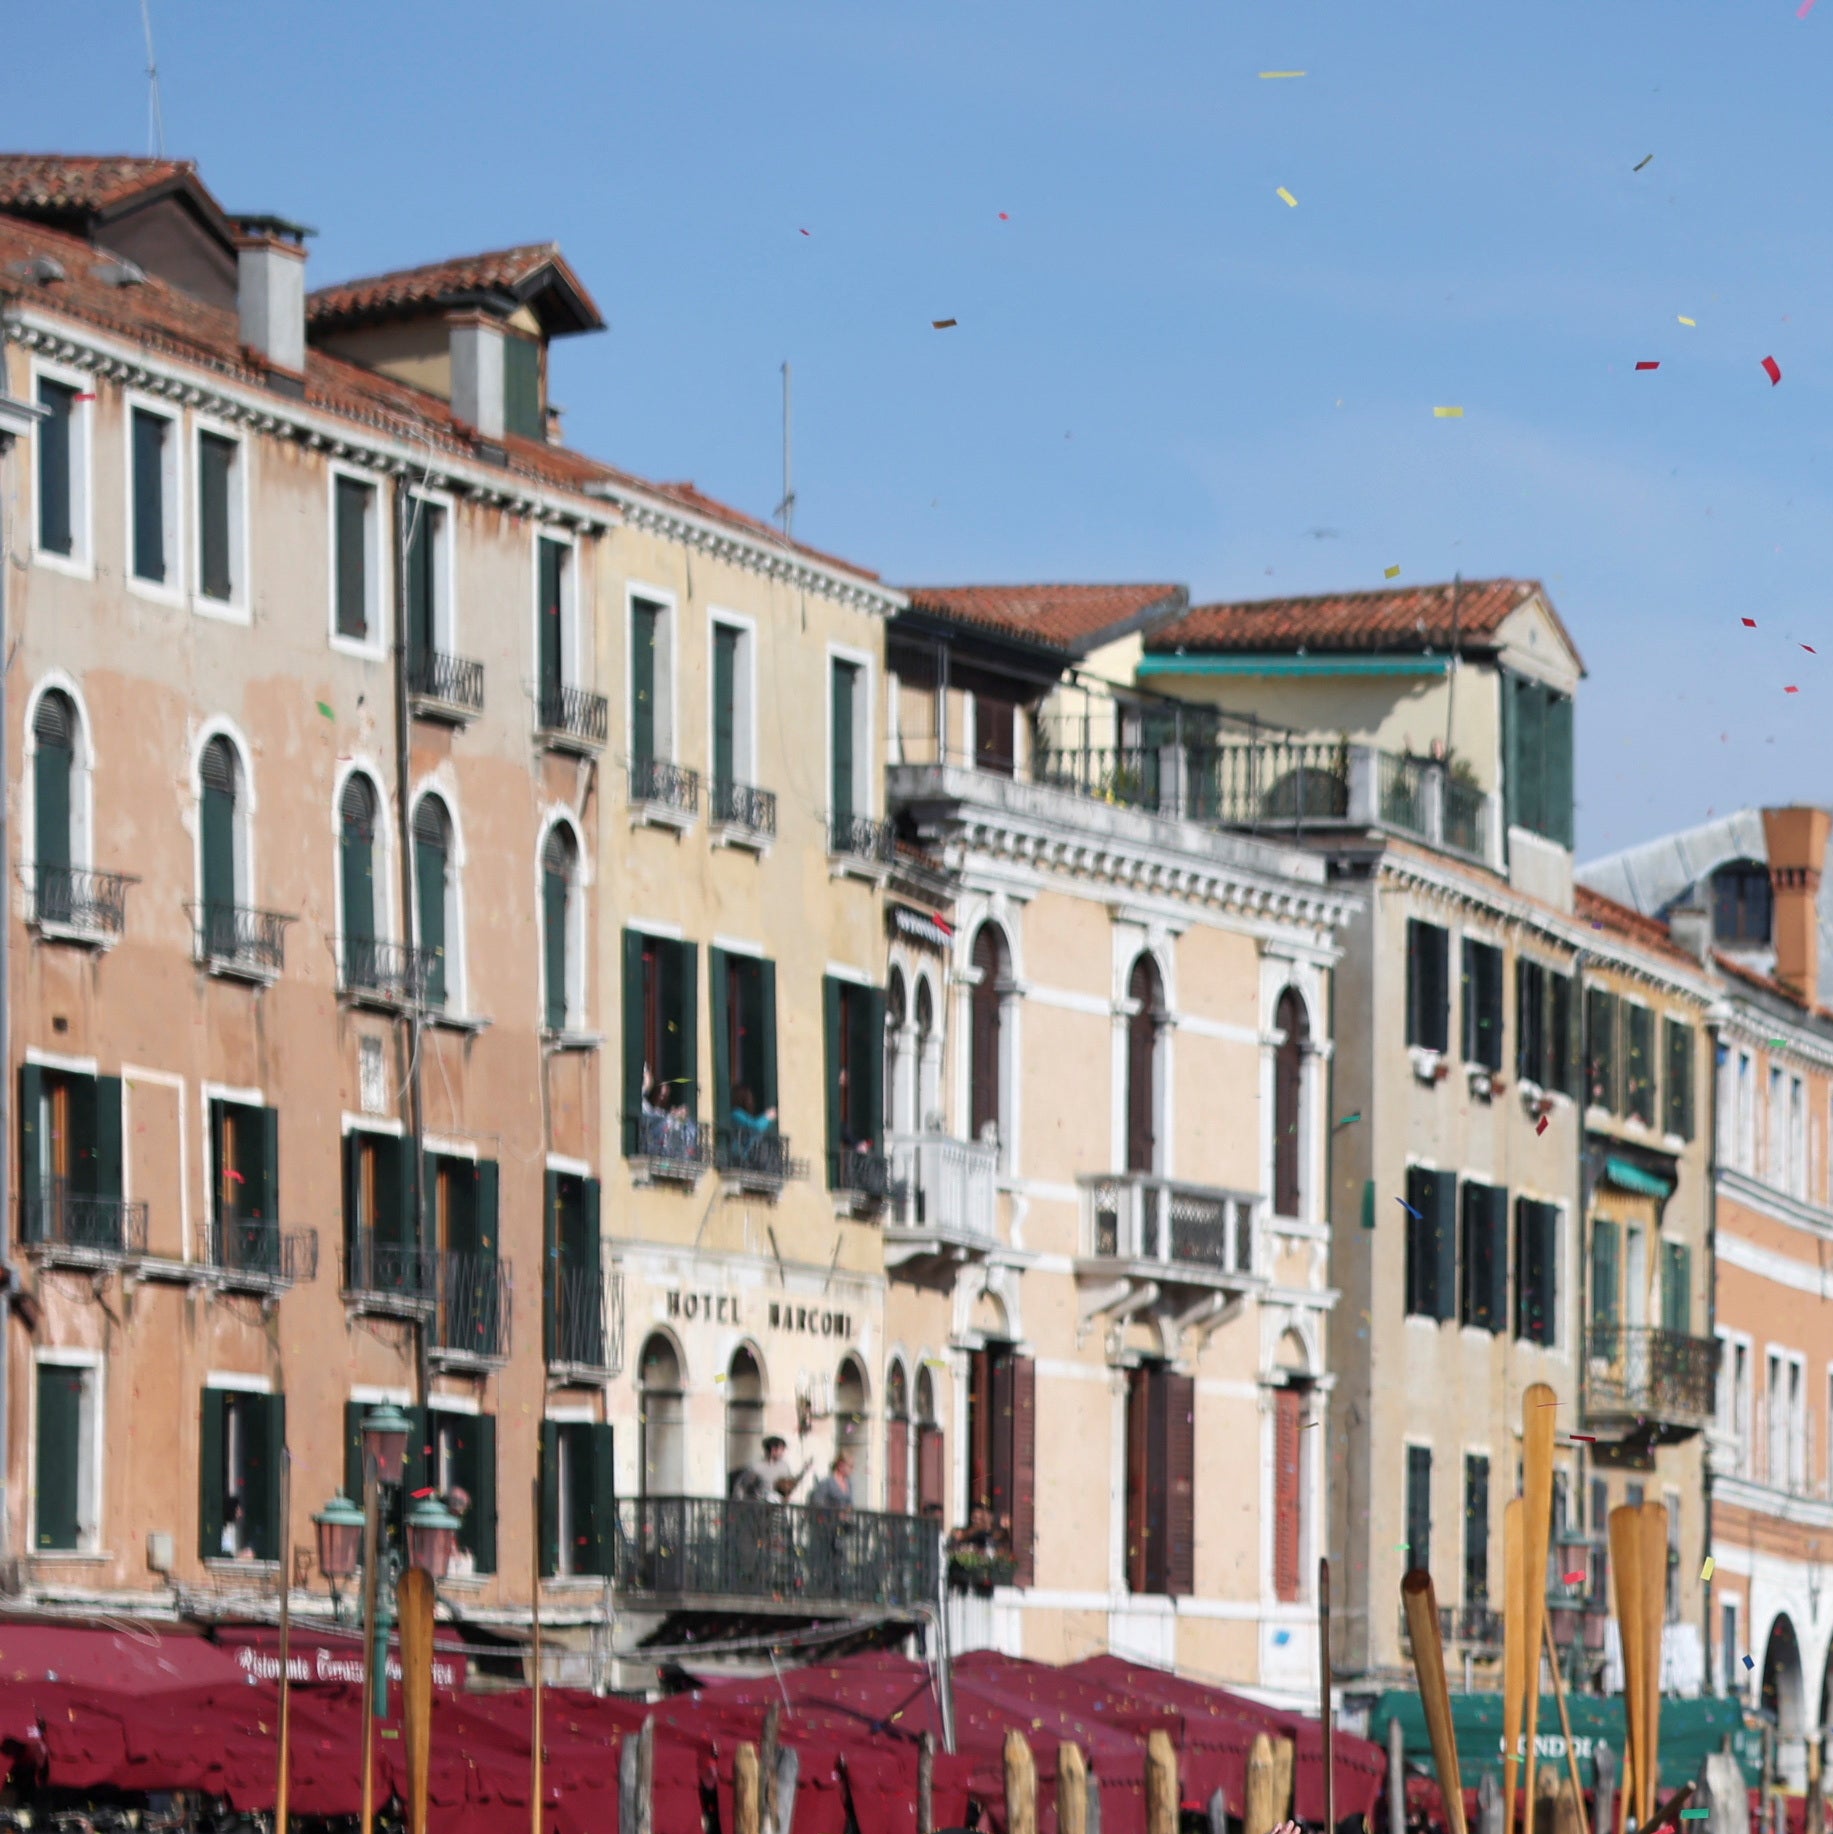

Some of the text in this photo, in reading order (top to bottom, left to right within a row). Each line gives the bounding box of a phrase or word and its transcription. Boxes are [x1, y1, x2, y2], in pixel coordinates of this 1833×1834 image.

[667, 1289, 852, 1341] HOTEL MARCONI
[235, 1648, 310, 1681] Ristornte
[316, 1647, 365, 1684] Terrazz
